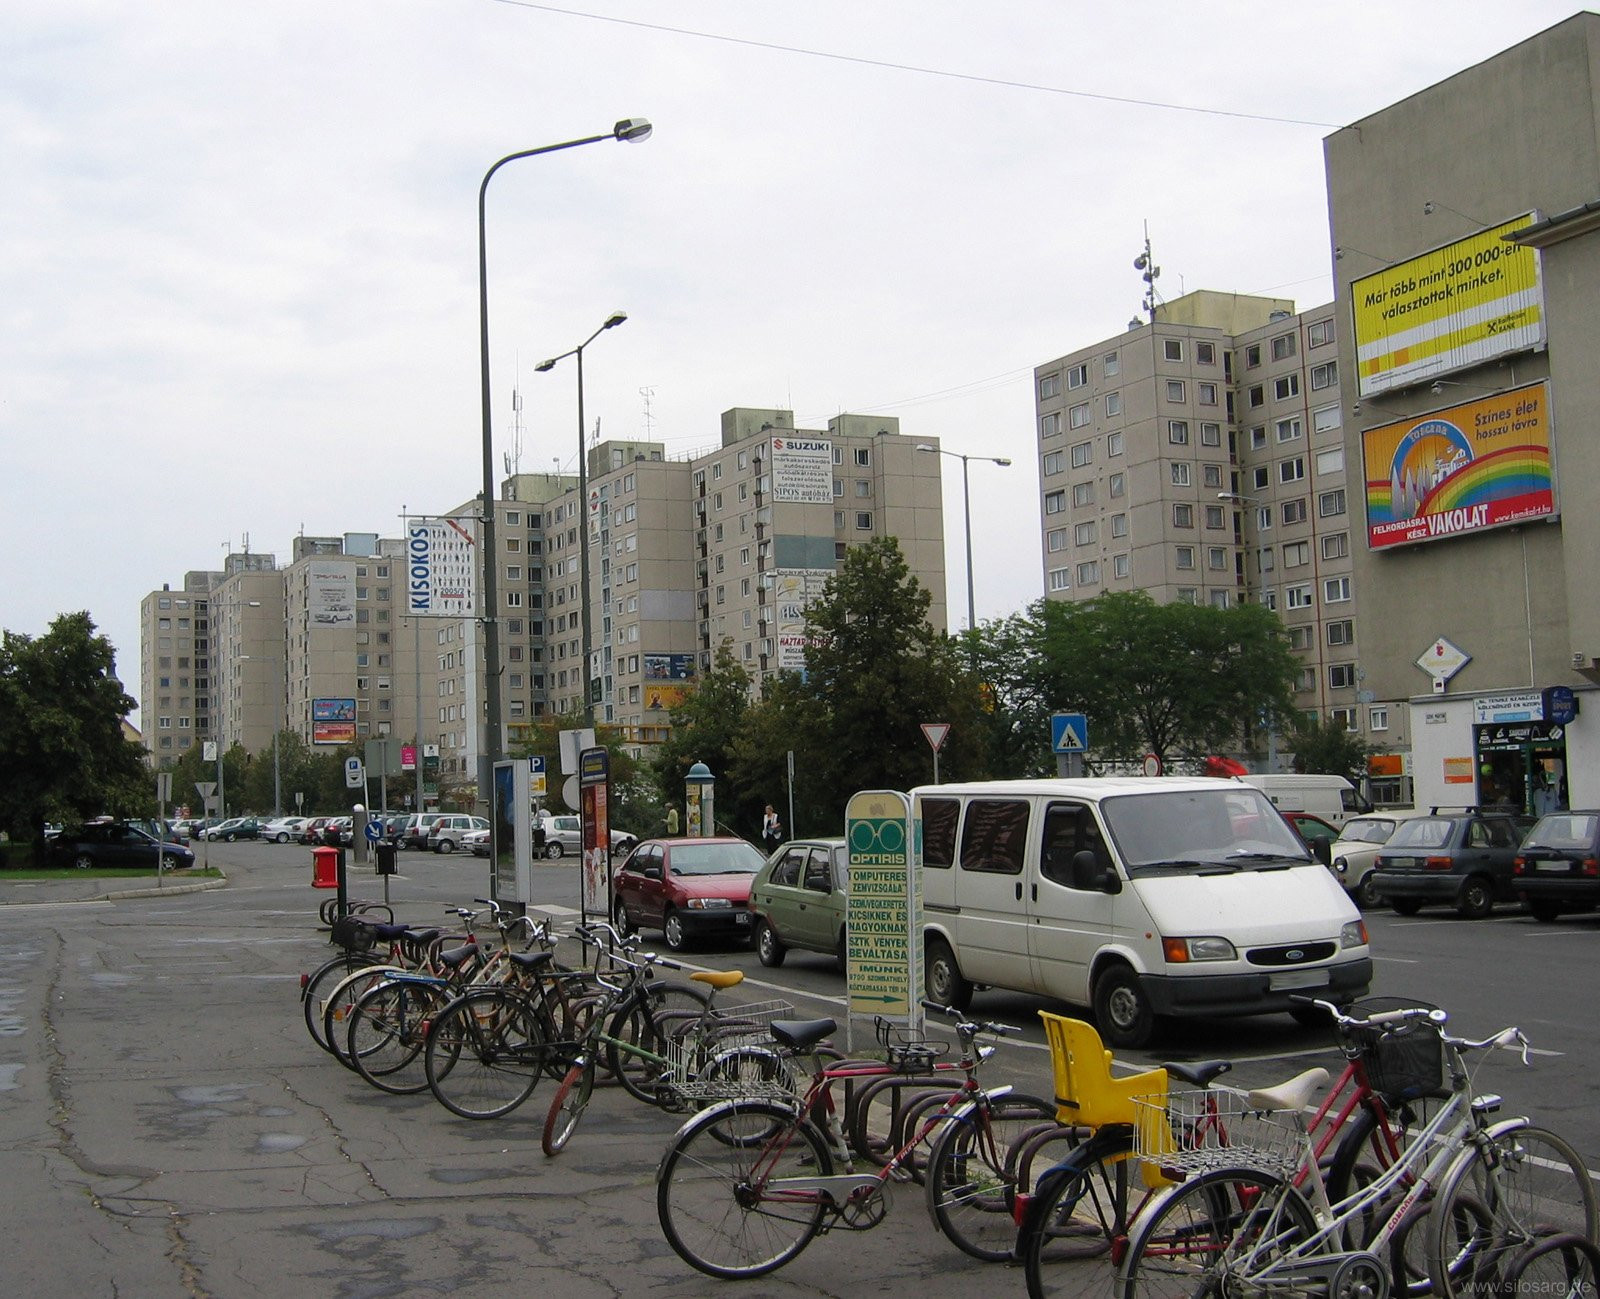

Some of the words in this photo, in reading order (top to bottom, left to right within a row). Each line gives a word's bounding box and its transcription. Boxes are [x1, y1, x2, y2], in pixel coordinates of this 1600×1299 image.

[1365, 290, 1388, 308] Már
[1419, 270, 1446, 288] mint
[1448, 257, 1472, 277] 300
[1382, 284, 1453, 320] választottak
[1457, 267, 1504, 294] minket.
[1475, 409, 1511, 427] Színes
[1516, 400, 1538, 417] élet
[1476, 424, 1508, 441] hosszú
[1512, 418, 1538, 433] távra
[786, 441, 829, 451] SUZUKI
[774, 487, 799, 496] SIPOS
[1373, 516, 1426, 535] FELHORDÁSRA
[1407, 527, 1427, 540] KÉSZ
[1427, 504, 1489, 536] VAKOLAT
[411, 528, 430, 609] KISOKOS
[532, 758, 541, 772] P
[850, 853, 905, 864] OPTIRIS
[849, 911, 892, 921] KICSIKNEK
[849, 922, 908, 932] NAGYOKNAK
[849, 937, 870, 946] SZTK
